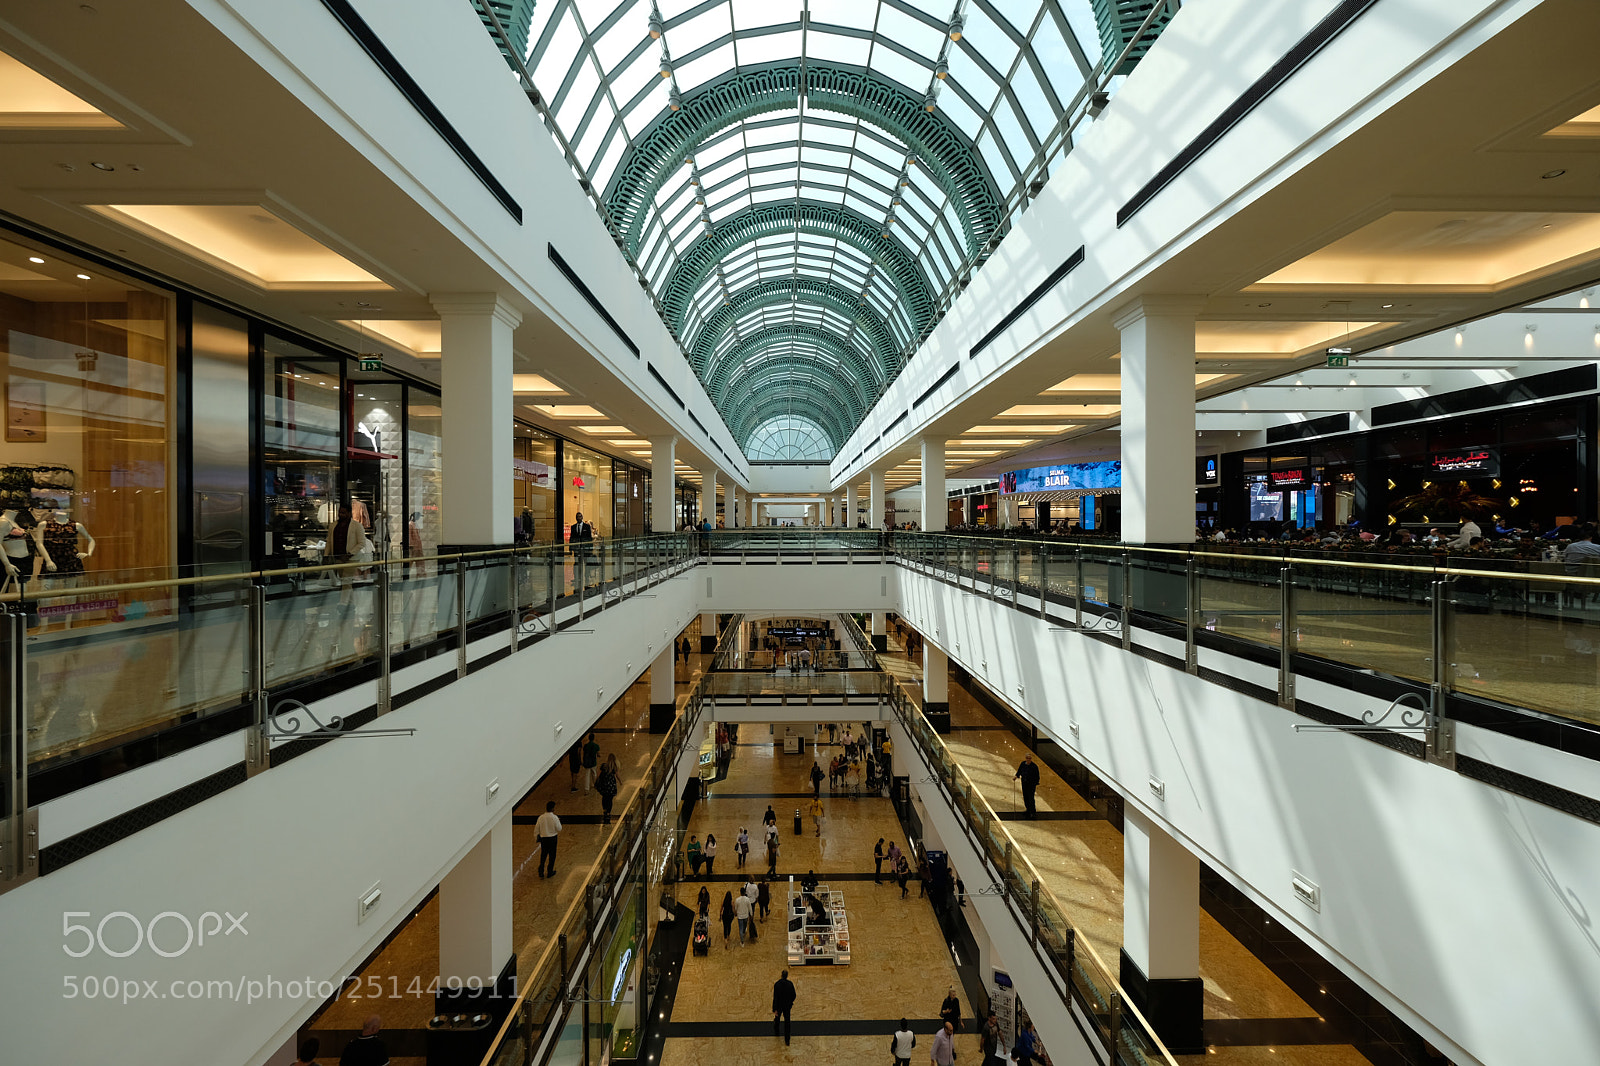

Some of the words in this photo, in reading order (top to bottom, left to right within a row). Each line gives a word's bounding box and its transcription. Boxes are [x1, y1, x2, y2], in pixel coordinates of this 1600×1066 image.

[1045, 475, 1069, 486] BLAIR
[40, 606, 62, 617] CASH
[64, 604, 85, 614] BACK
